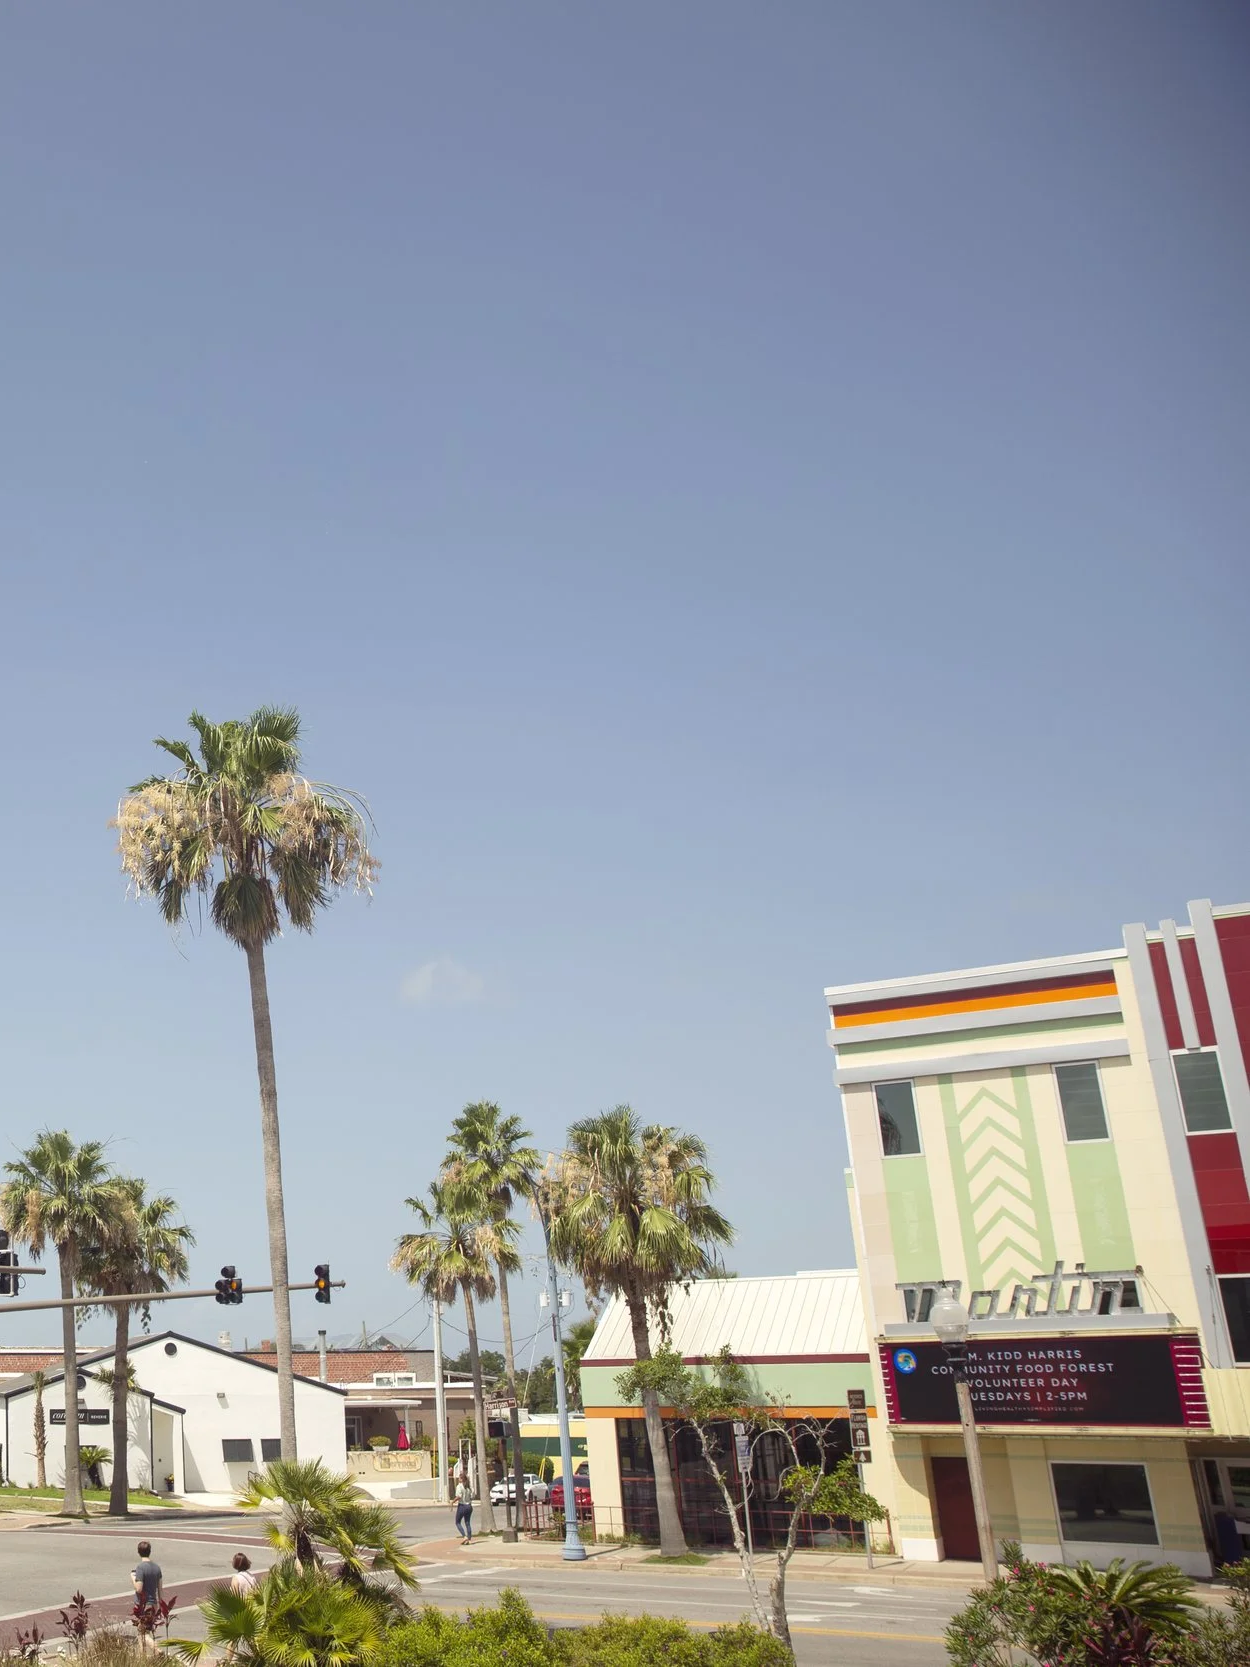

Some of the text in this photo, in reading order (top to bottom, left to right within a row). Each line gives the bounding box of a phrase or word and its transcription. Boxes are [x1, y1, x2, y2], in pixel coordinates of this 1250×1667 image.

[987, 1351, 1022, 1361] KIDD
[1027, 1350, 1082, 1359] HARRIS
[1016, 1364, 1054, 1374] FOOD
[1059, 1363, 1114, 1373] FOREST
[966, 1378, 1079, 1388] VOLUNTEER DAY
[970, 1392, 1031, 1401] UESDAYS
[1046, 1391, 1088, 1401] 2-5PM
